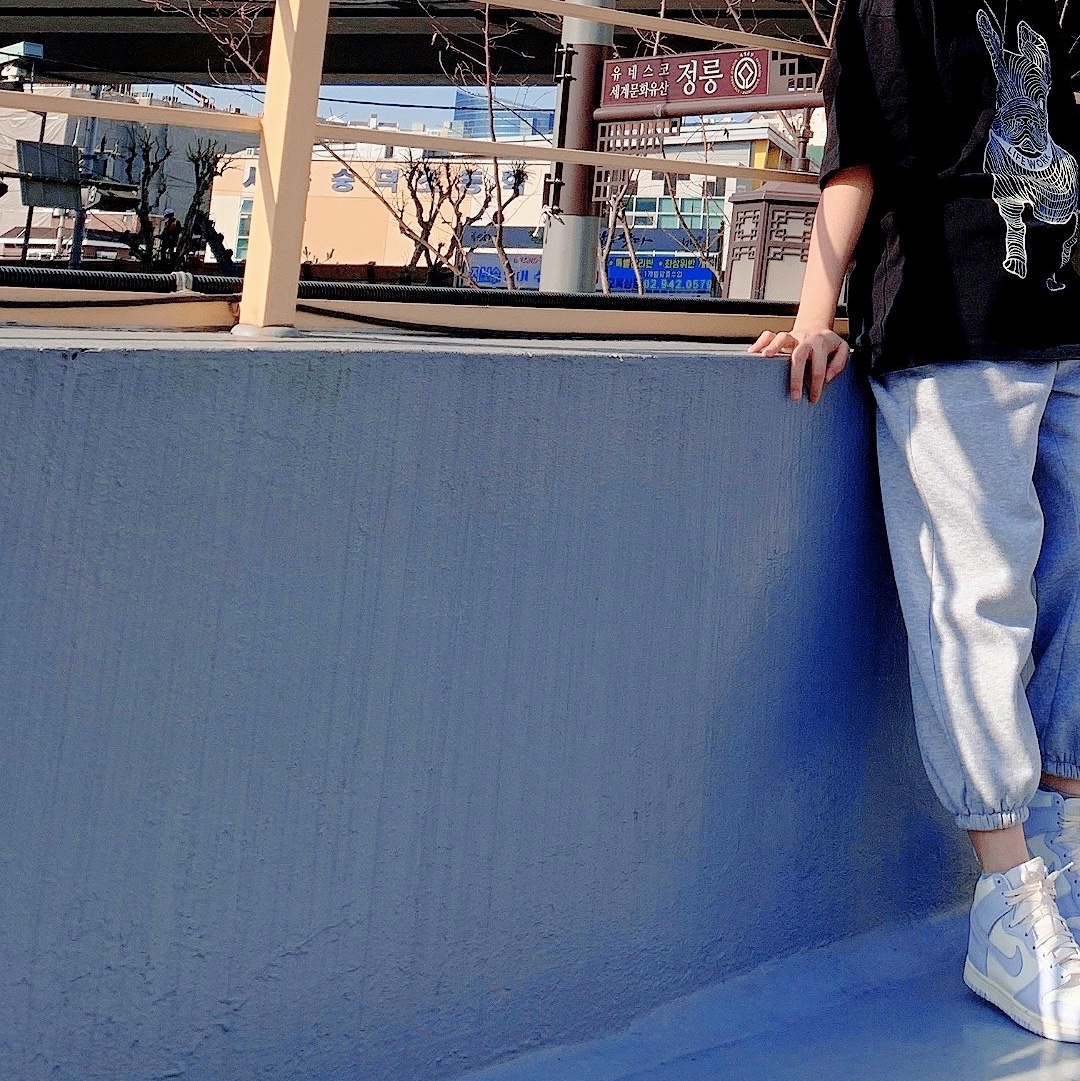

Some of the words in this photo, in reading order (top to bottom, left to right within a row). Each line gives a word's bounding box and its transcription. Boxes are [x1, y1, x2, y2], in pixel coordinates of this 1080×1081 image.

[611, 63, 670, 82] 유네스코
[676, 59, 724, 96] 정릉
[609, 80, 670, 100] 세계문화유산
[1027, 152, 1052, 170] WORK
